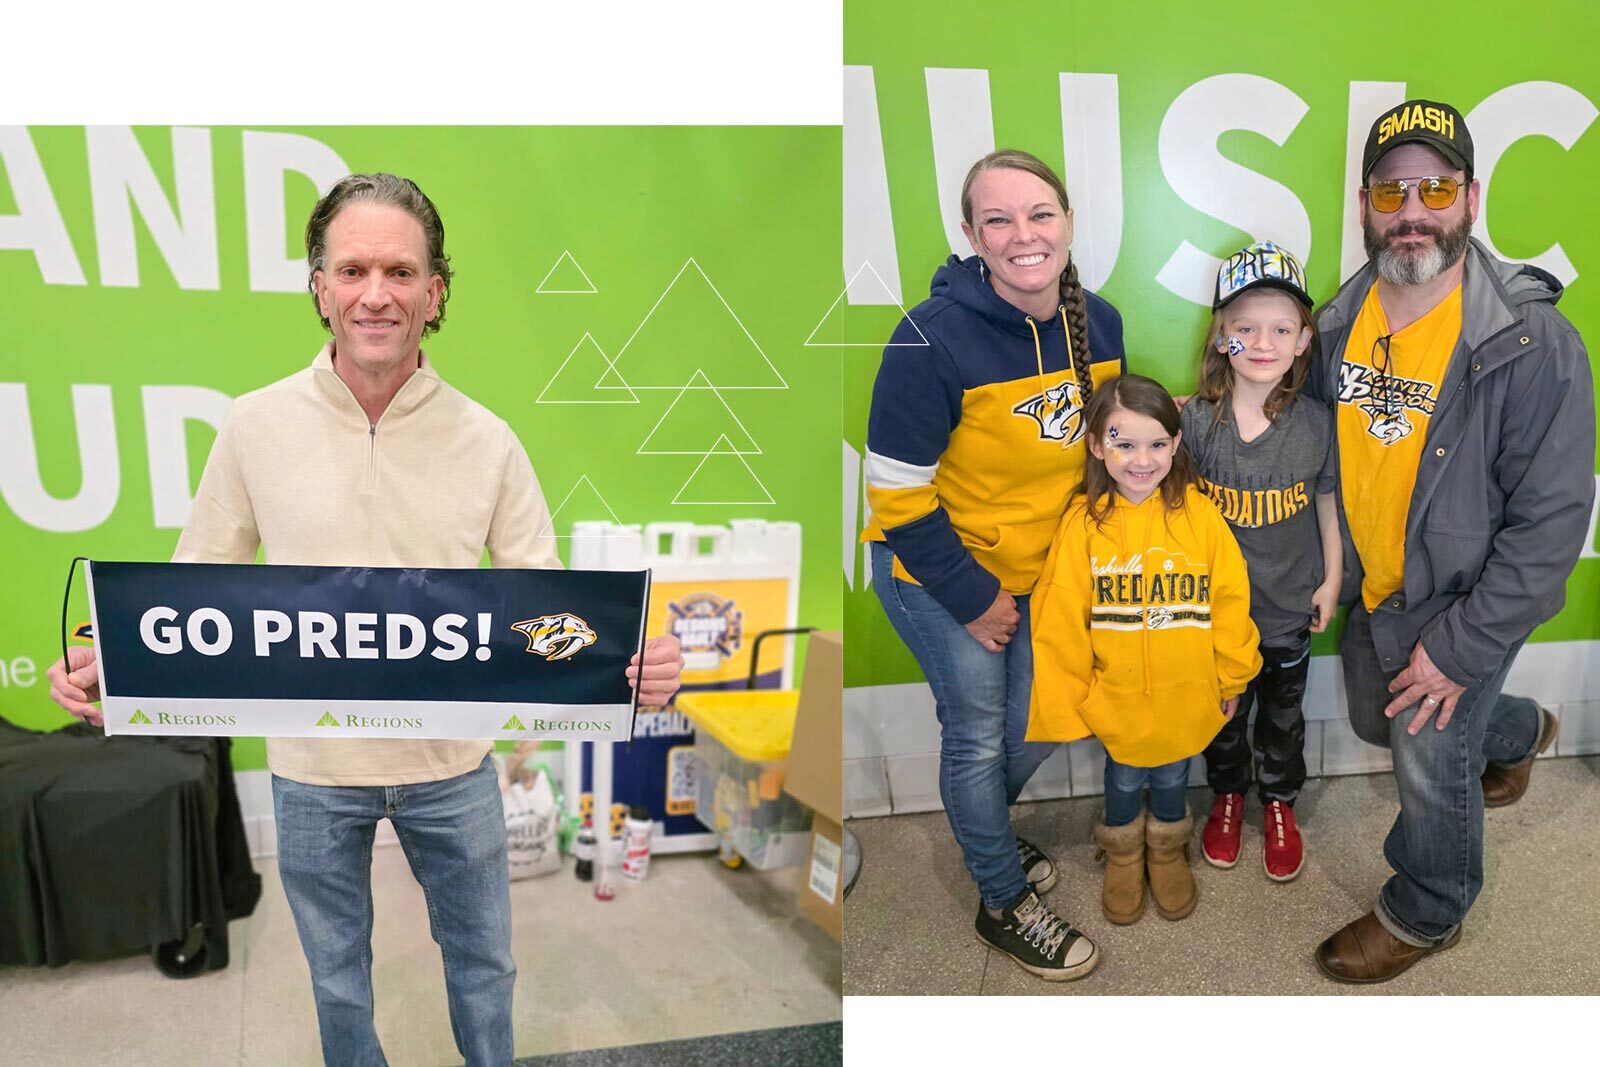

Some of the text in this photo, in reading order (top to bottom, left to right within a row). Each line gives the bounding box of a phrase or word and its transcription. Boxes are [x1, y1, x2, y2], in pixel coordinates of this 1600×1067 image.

[1377, 104, 1455, 145] SMASH
[139, 606, 492, 662] GO PREDS!
